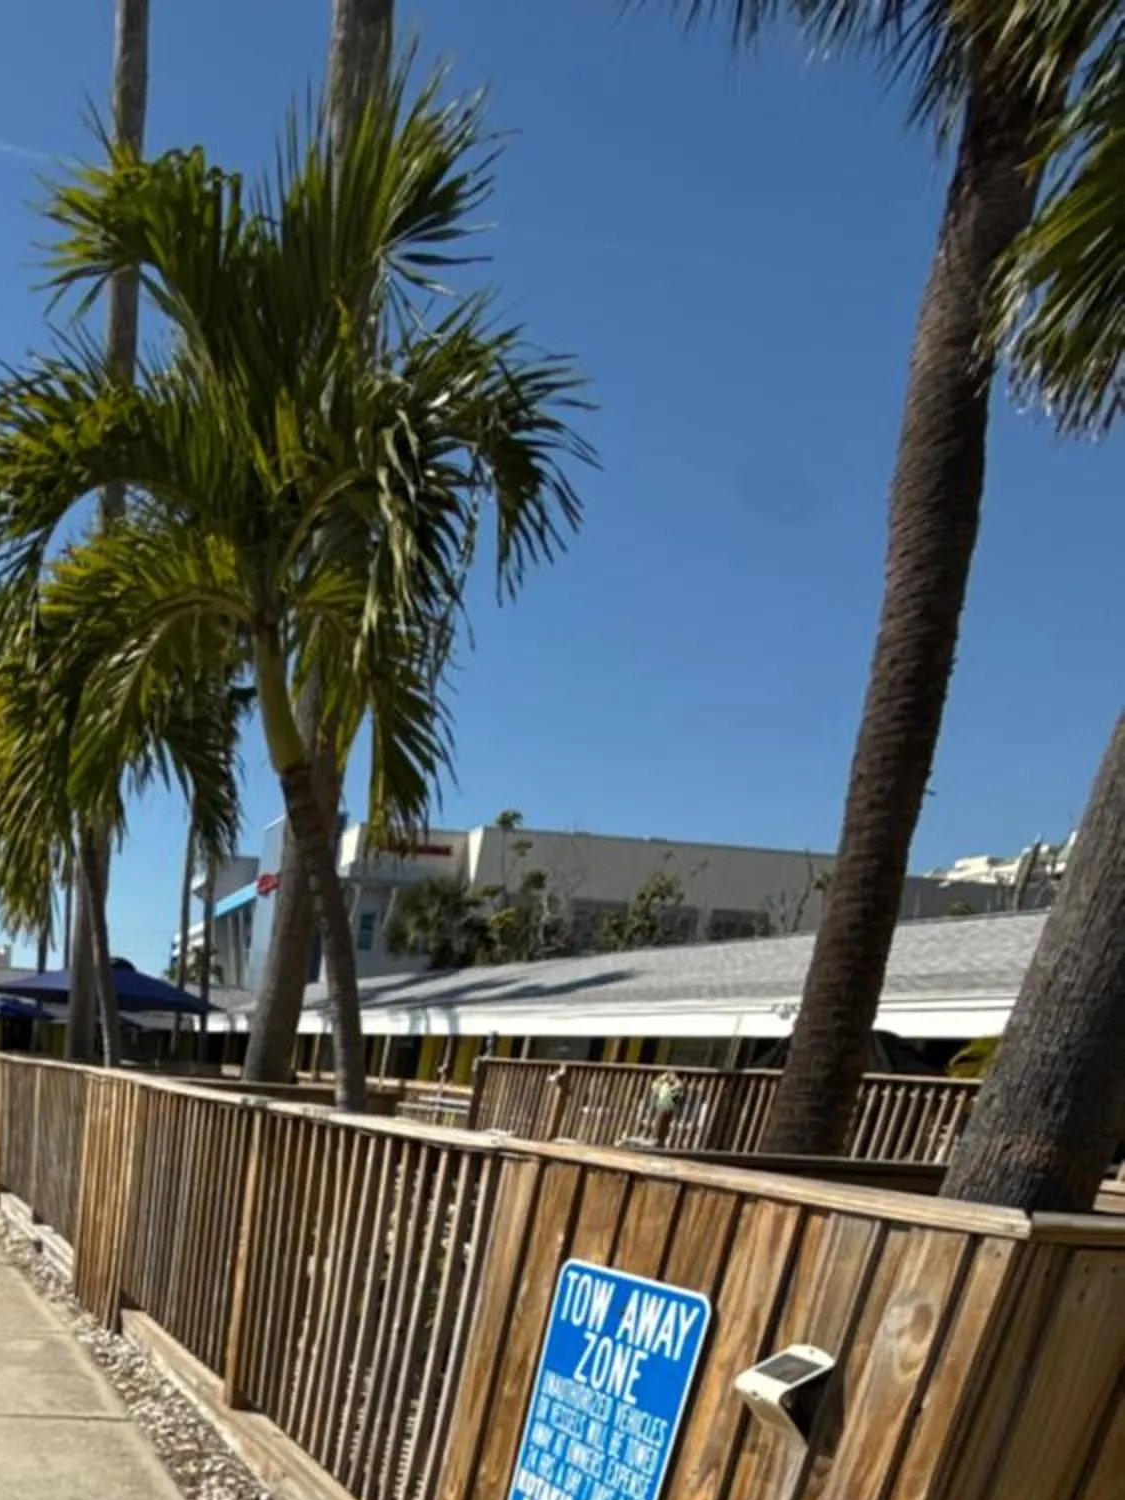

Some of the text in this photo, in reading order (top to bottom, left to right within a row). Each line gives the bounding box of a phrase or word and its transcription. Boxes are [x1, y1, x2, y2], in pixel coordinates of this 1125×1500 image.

[560, 1271, 699, 1361] TOW AWAY
[574, 1332, 648, 1404] ZONE
